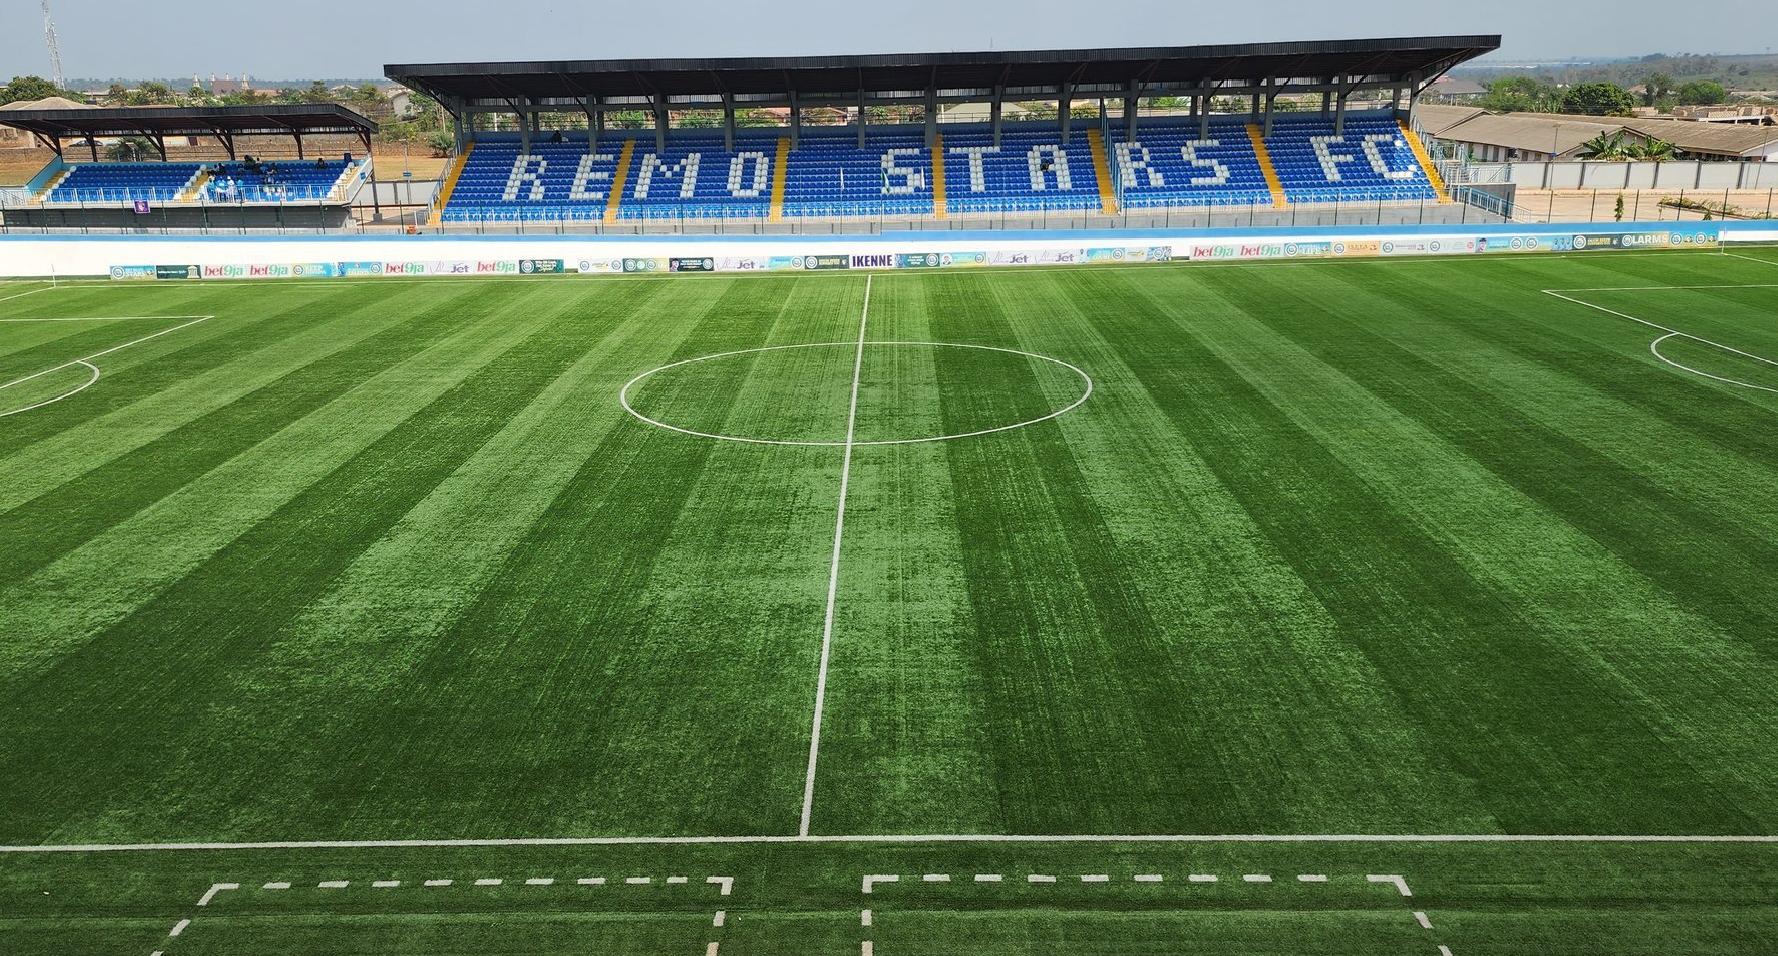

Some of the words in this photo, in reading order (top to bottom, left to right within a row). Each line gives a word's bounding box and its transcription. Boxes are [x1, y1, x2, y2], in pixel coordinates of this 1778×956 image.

[502, 151, 770, 201] REMO
[880, 139, 1231, 194] STARS
[1309, 134, 1418, 181] FC
[1193, 245, 1234, 258] bet9ja
[1239, 244, 1281, 257] bet9ja
[477, 259, 516, 273] bet9ja
[852, 254, 893, 267] IKENNE
[204, 264, 244, 277] bet9ja
[249, 264, 289, 277] bet9ja
[385, 261, 425, 274] bet9ja
